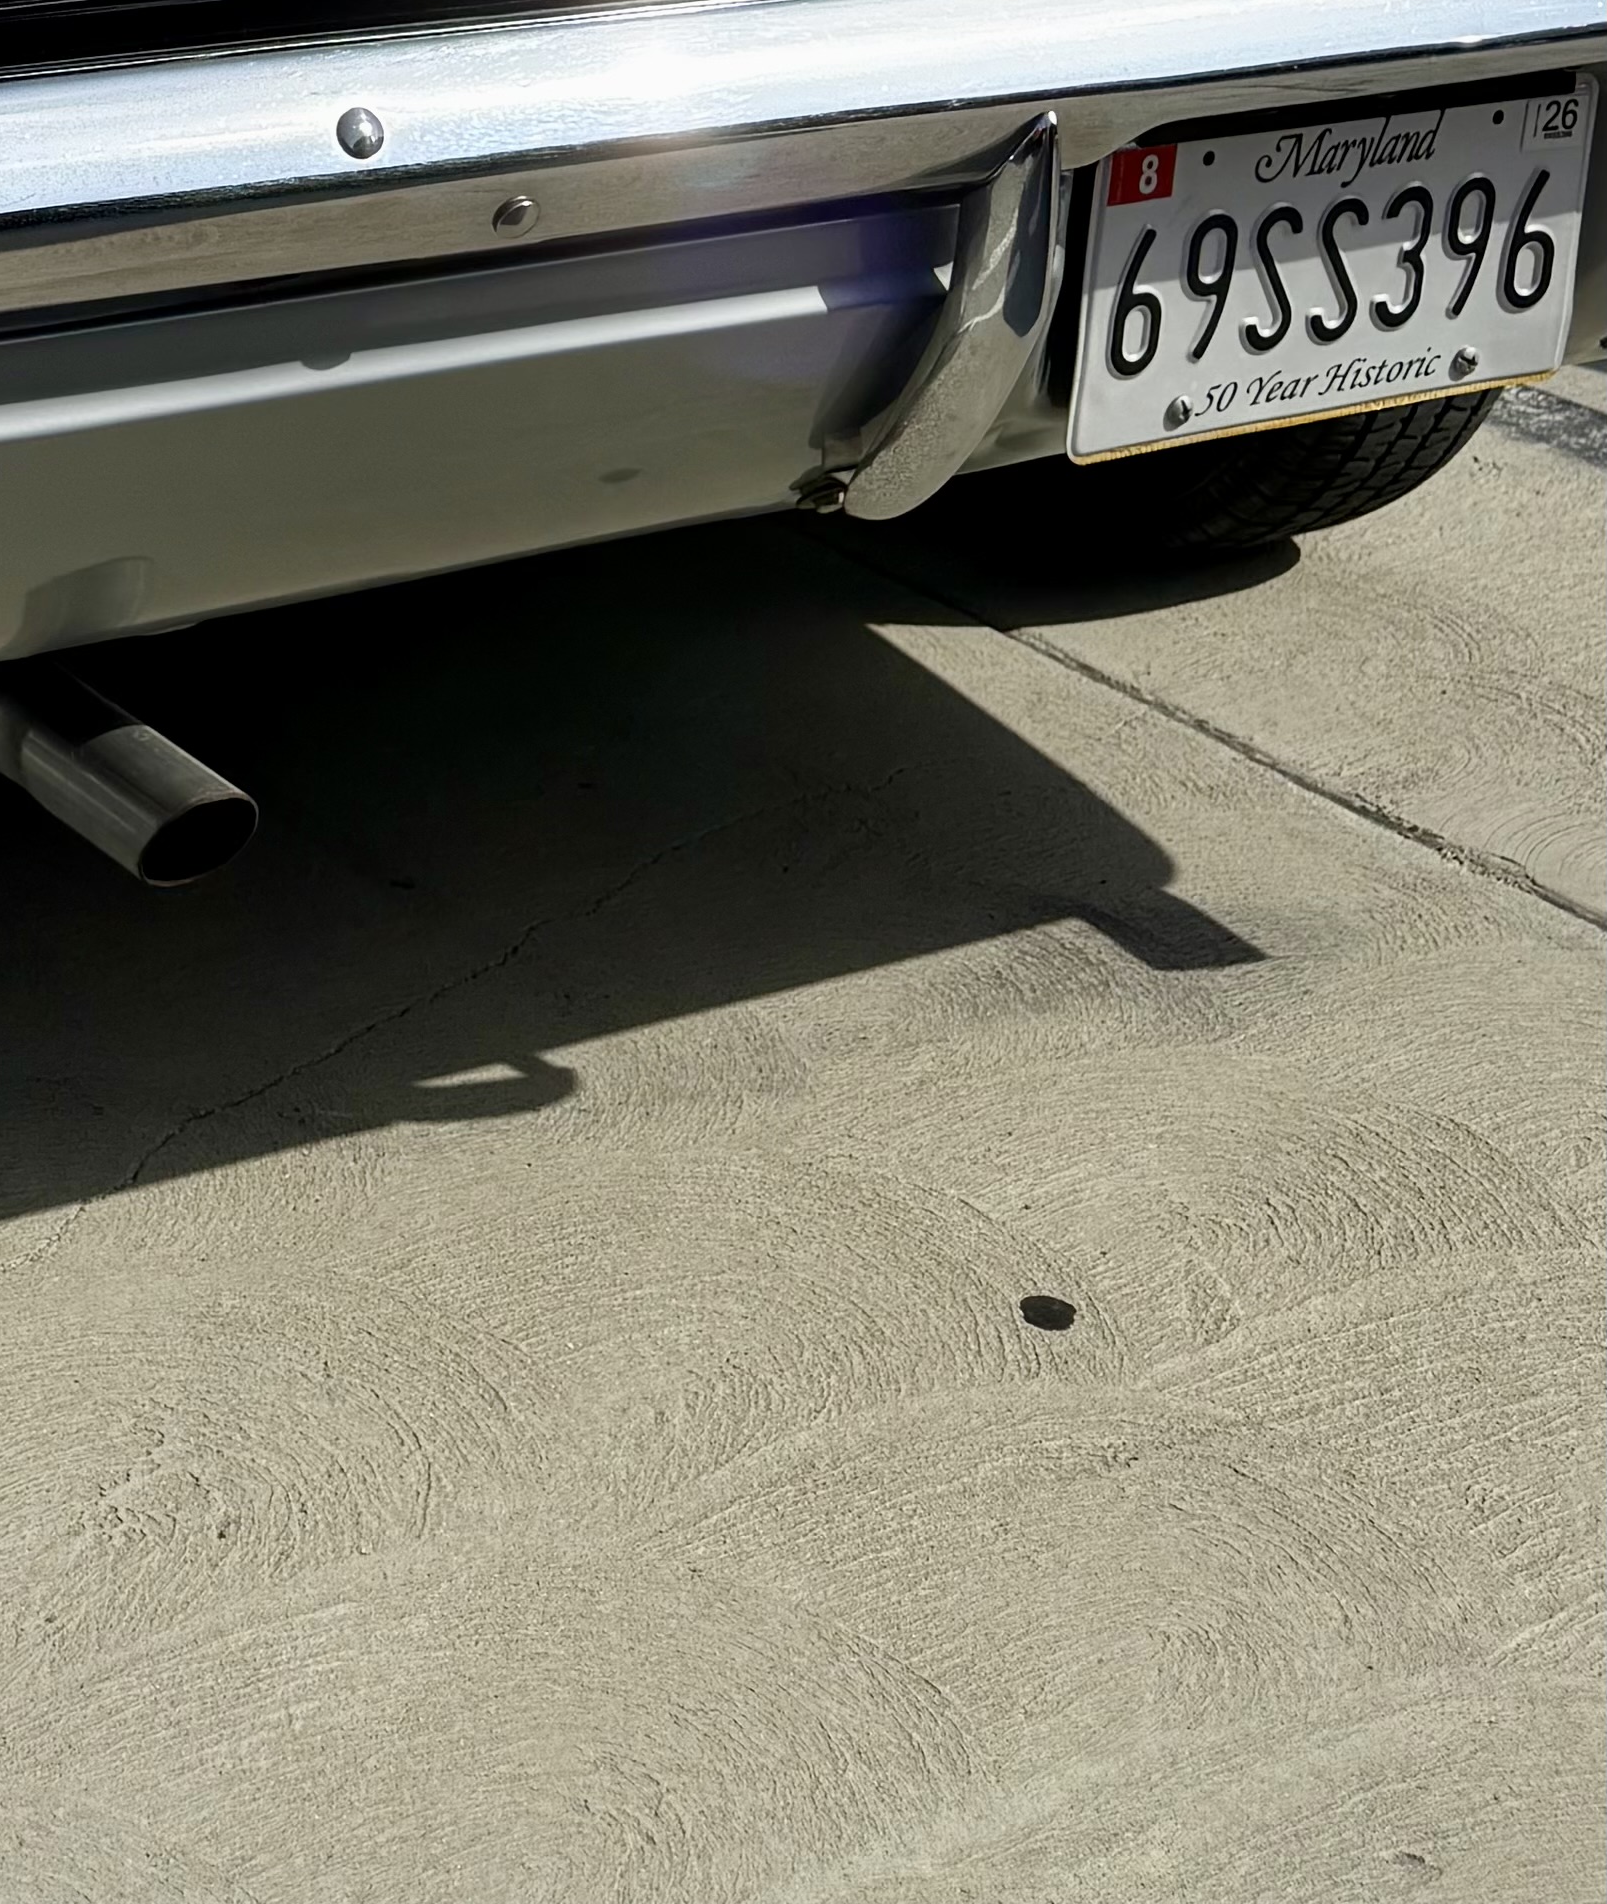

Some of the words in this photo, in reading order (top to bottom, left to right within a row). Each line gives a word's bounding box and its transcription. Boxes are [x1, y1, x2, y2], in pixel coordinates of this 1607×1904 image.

[1255, 107, 1444, 188] Maryland
[1542, 98, 1579, 131] 26
[1138, 154, 1159, 195] 8
[1108, 167, 1555, 378] 69SS396
[1194, 380, 1238, 418] 50
[1245, 372, 1320, 409] Year
[1321, 346, 1442, 397] Historic
